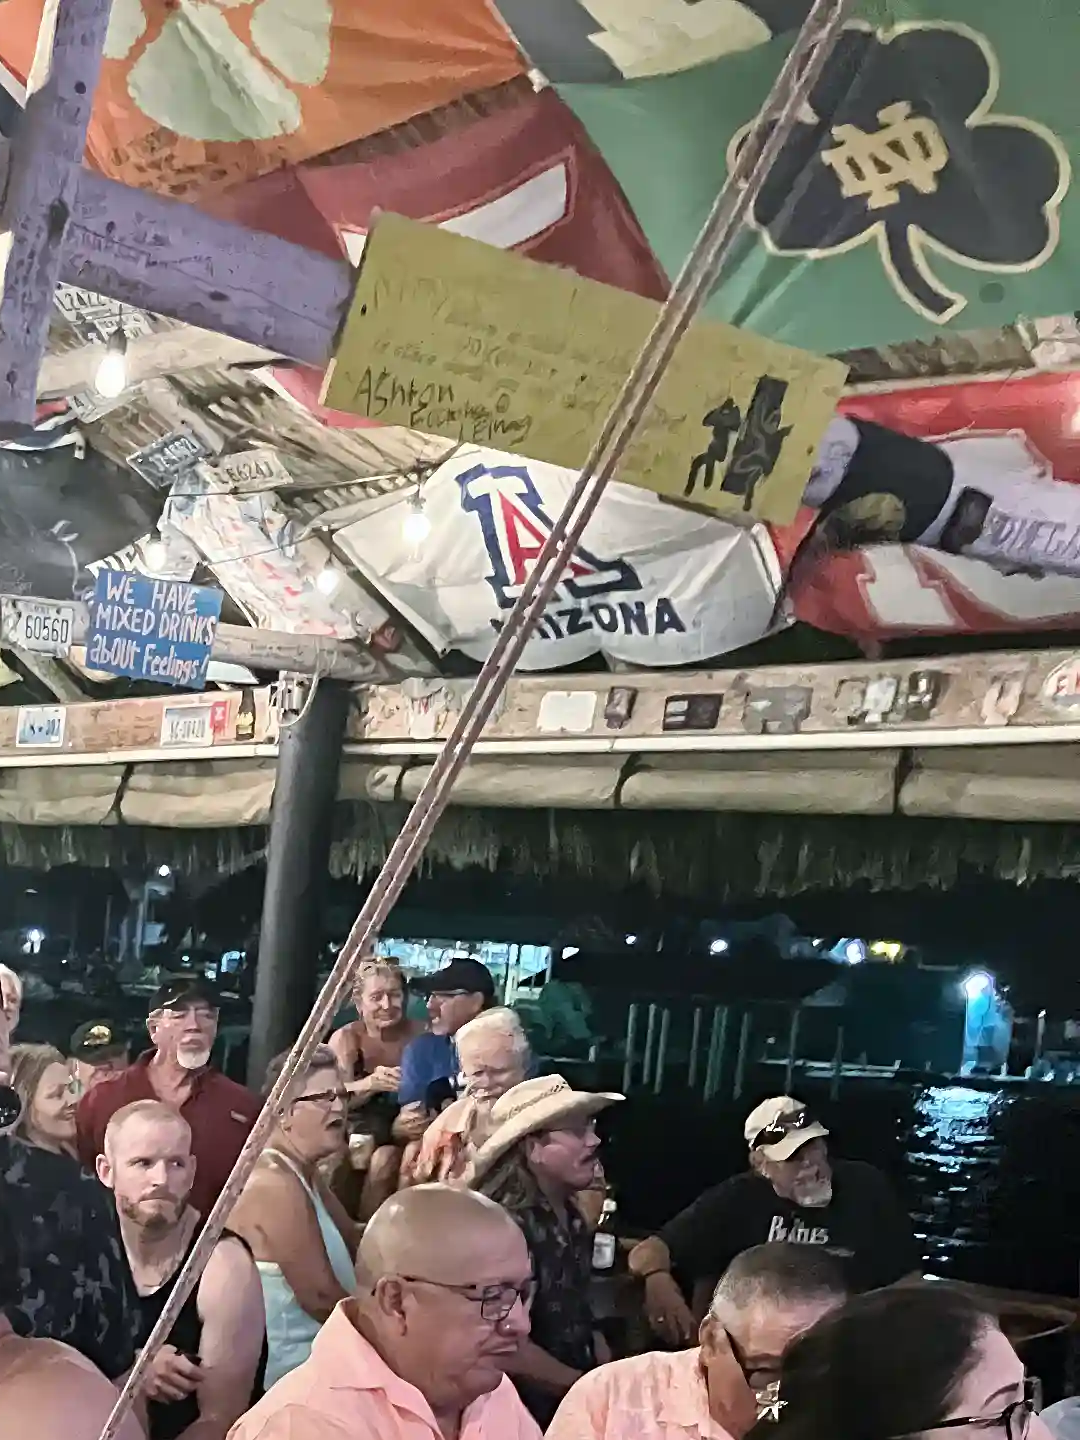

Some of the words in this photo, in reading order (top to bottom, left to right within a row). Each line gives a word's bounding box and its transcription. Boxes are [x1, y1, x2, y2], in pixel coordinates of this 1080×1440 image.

[107, 571, 137, 605] WE
[151, 580, 200, 615] HAVE
[96, 602, 156, 636] MIXED
[158, 611, 216, 646] DRINKS
